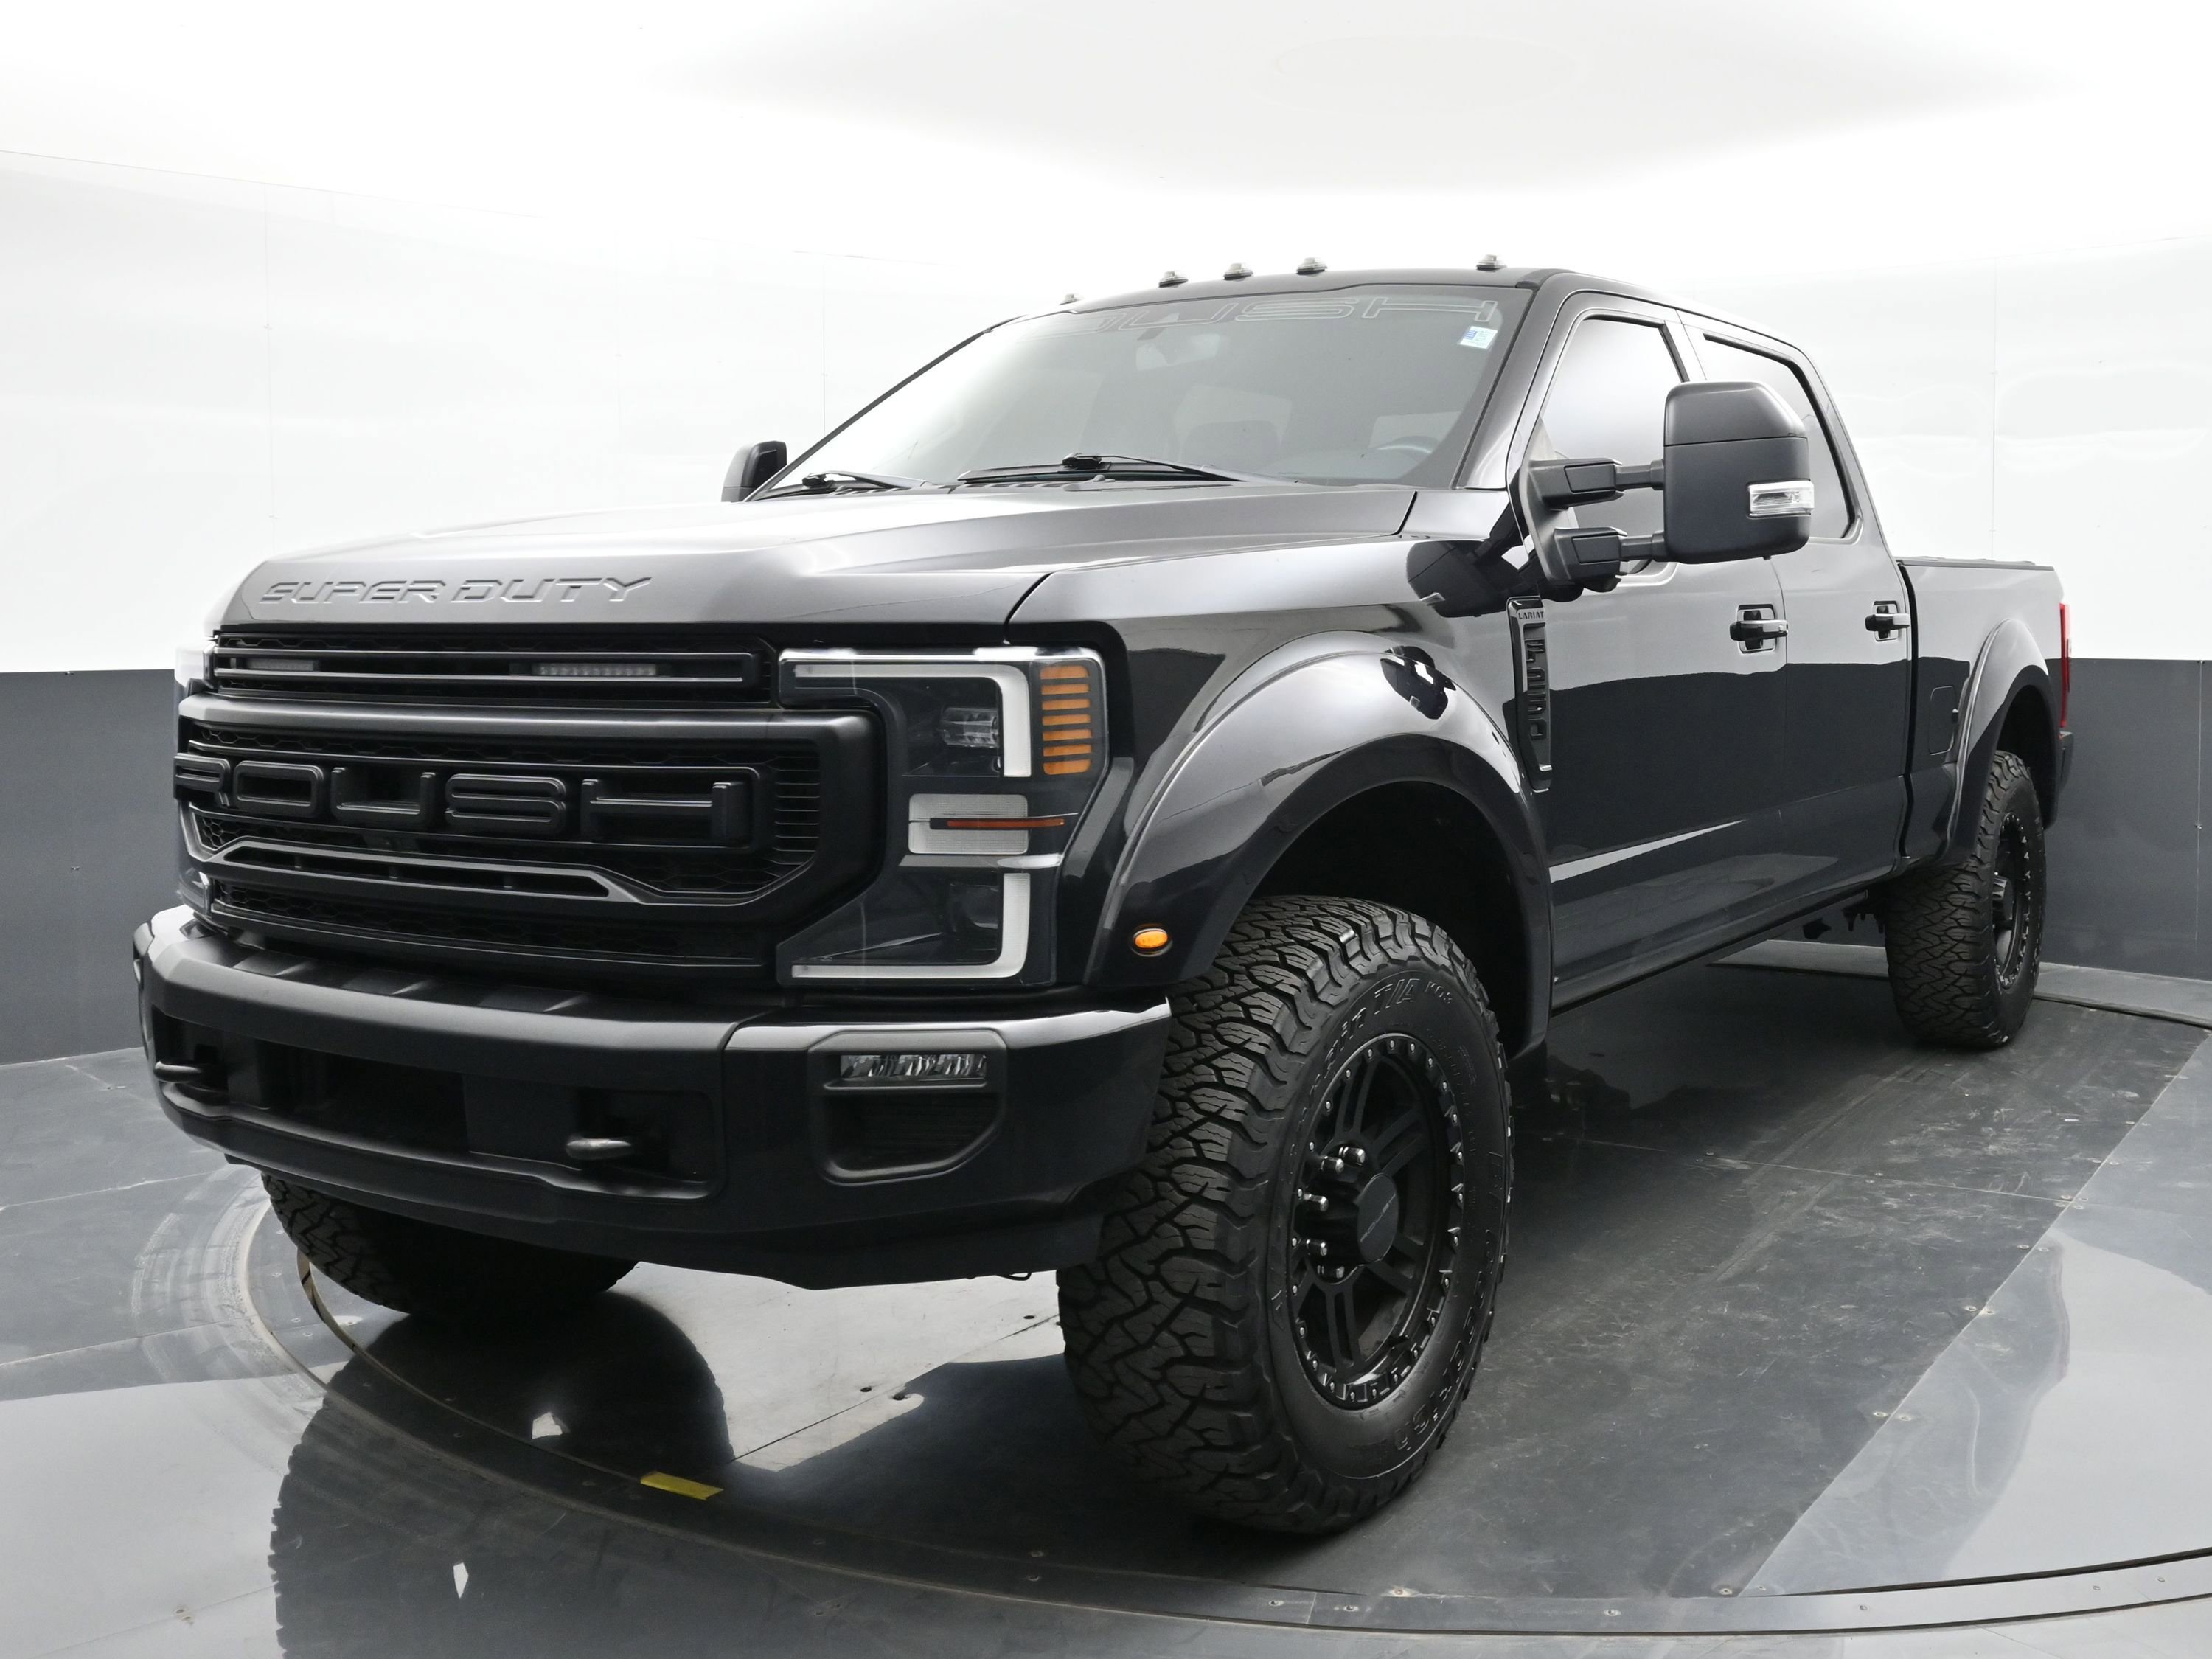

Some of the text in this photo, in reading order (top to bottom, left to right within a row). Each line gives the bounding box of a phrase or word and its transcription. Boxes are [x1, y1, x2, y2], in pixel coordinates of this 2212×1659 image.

[259, 577, 652, 603] SUPER DUTY
[1517, 611, 1545, 621] LARIAT
[173, 752, 742, 845] ROUSH
